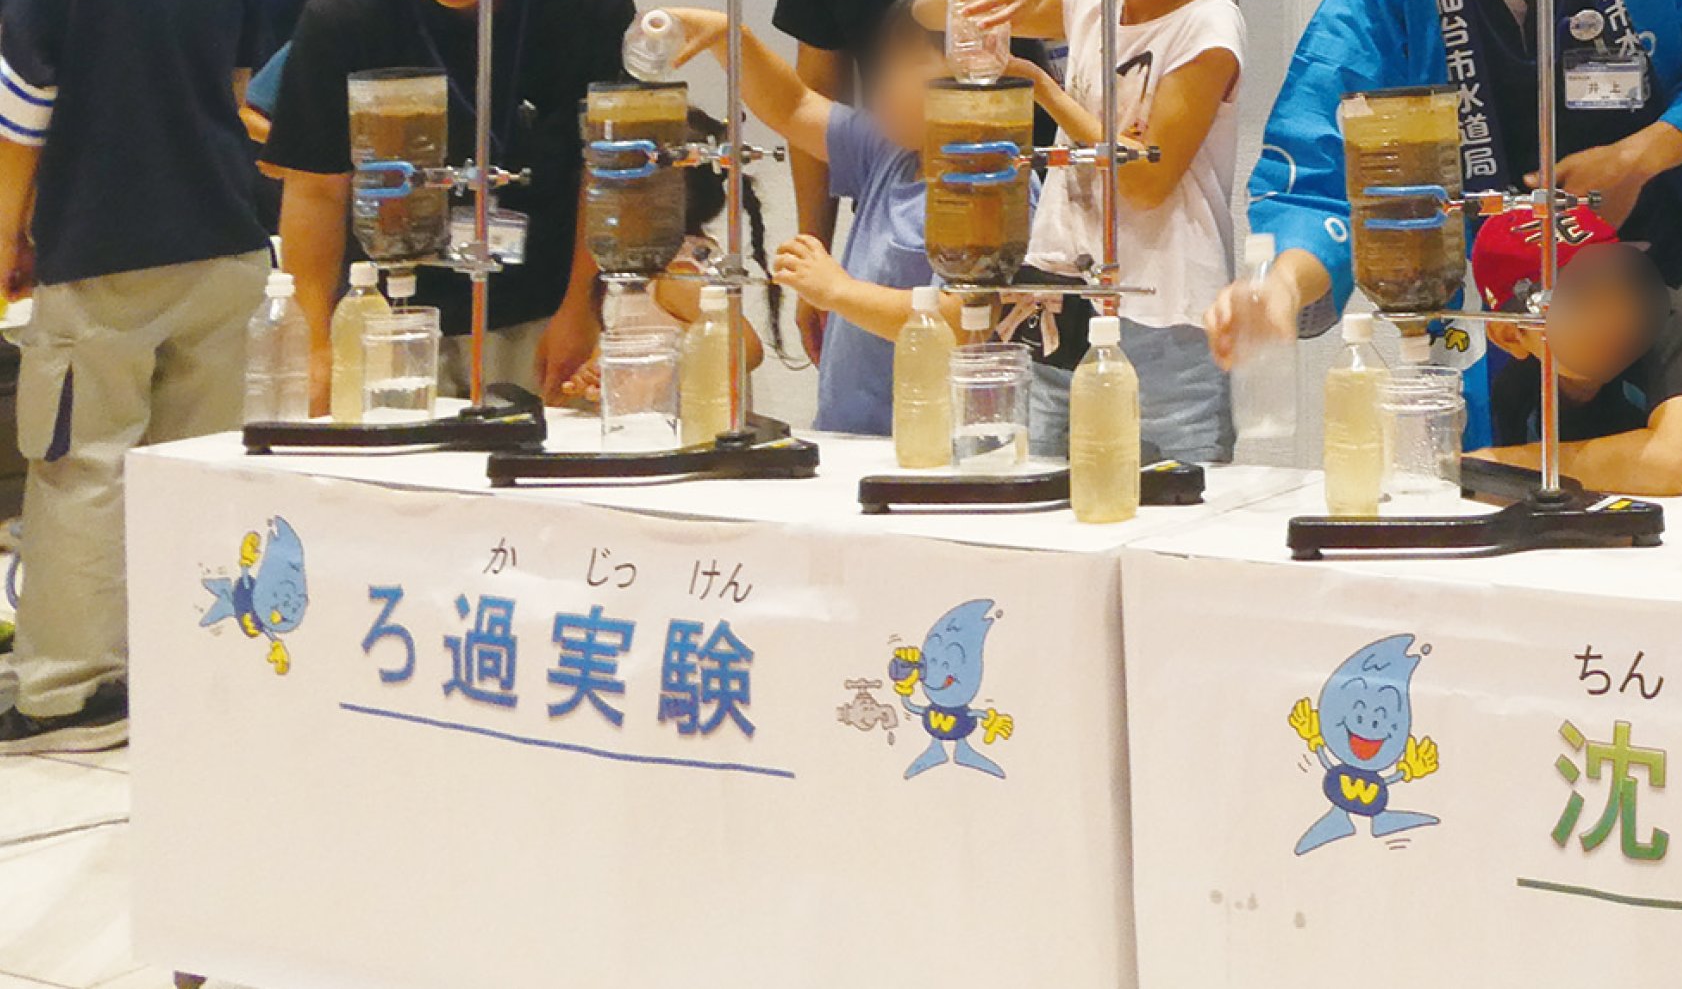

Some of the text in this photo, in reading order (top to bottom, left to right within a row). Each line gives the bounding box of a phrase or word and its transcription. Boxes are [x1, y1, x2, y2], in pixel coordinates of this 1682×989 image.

[484, 537, 753, 604] か じっ けん
[361, 584, 758, 739] ろ過実験
[1574, 644, 1664, 701] ちん
